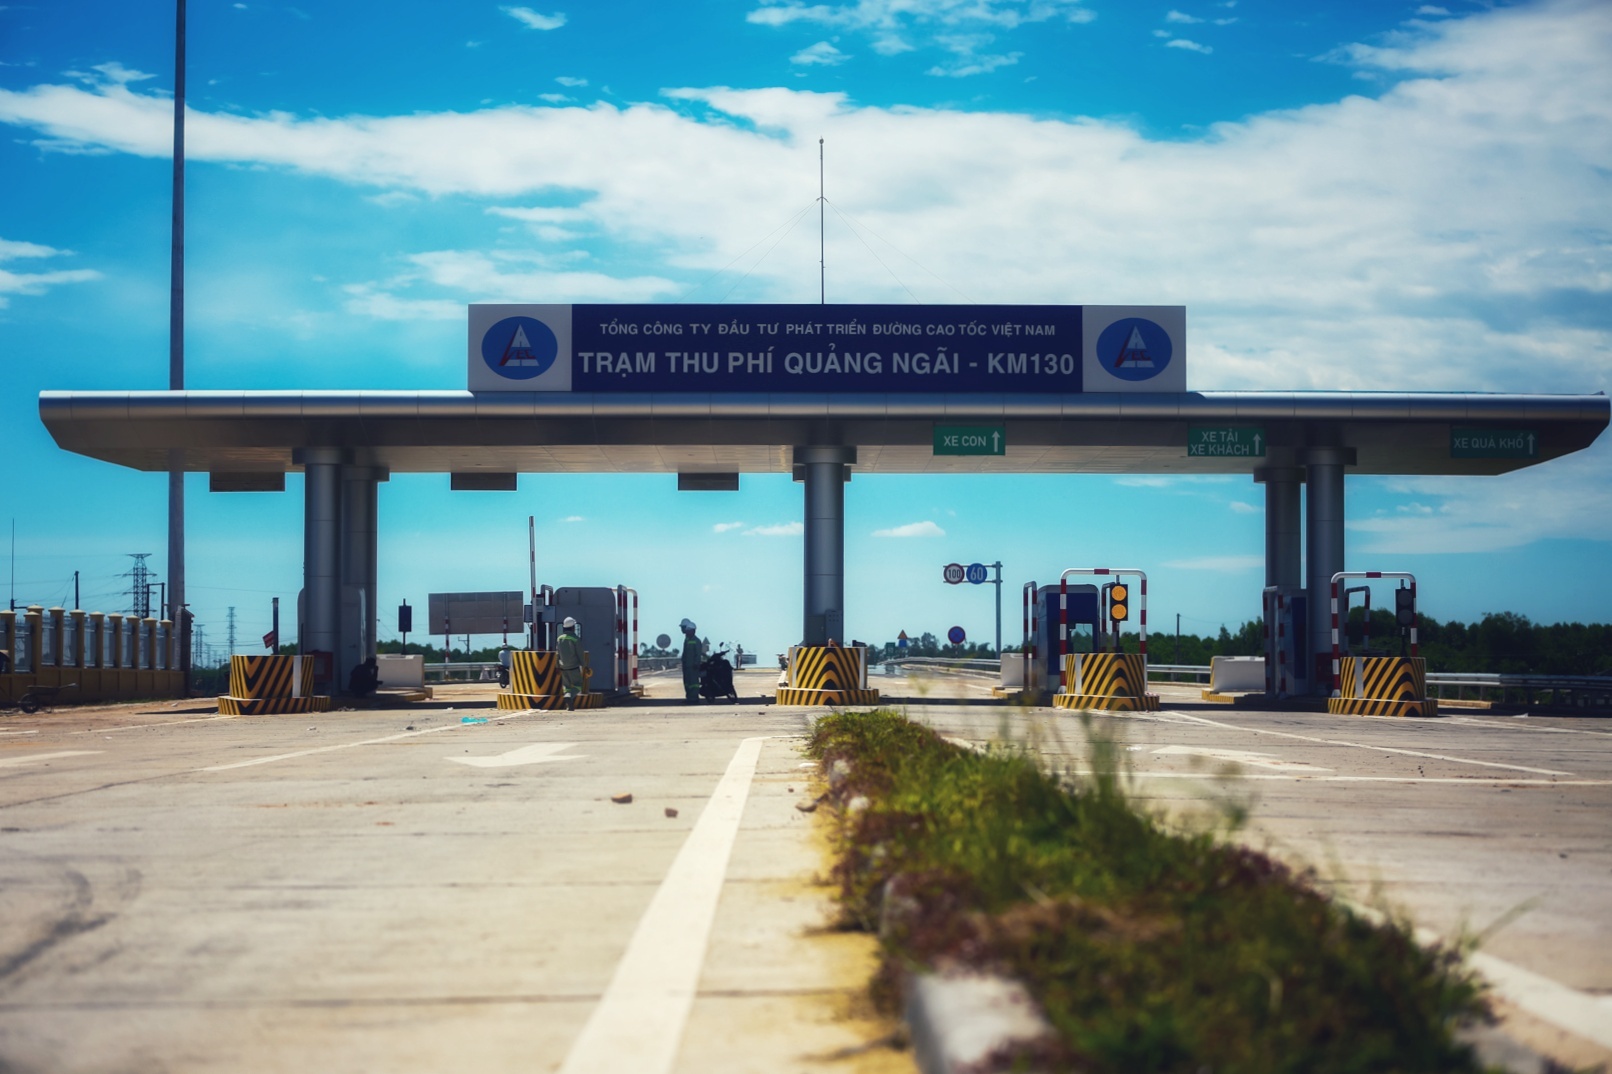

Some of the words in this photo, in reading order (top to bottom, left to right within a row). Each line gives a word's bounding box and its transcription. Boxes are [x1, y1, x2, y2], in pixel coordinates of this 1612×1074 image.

[599, 318, 638, 335] TỔNG
[643, 321, 683, 335] CÔNG
[689, 323, 712, 335] TY
[718, 319, 750, 335] ĐẦU
[757, 322, 780, 335] TƯ
[786, 321, 822, 335] PHÁT
[826, 319, 866, 335] TRIỂN
[872, 322, 922, 335] ĐƯỜNG
[926, 324, 955, 335] CAO
[958, 320, 987, 335] TỐC
[991, 322, 1022, 337] VIỆT
[1025, 324, 1055, 336] NAM
[578, 352, 656, 377] TRẠM
[665, 352, 719, 374] THU
[728, 346, 774, 373] PHÍ
[784, 343, 882, 374] QUẢNG
[892, 346, 959, 374] NGÃI
[987, 353, 1074, 375] KM130
[943, 435, 959, 447] XE
[961, 435, 986, 447] CON
[1201, 431, 1217, 442] XE
[1219, 428, 1238, 442] TẢI
[1190, 444, 1205, 455] XE
[1208, 442, 1249, 455] KHÁCH
[1453, 437, 1469, 448] XE
[948, 568, 961, 579] 100
[970, 567, 984, 581] 60
